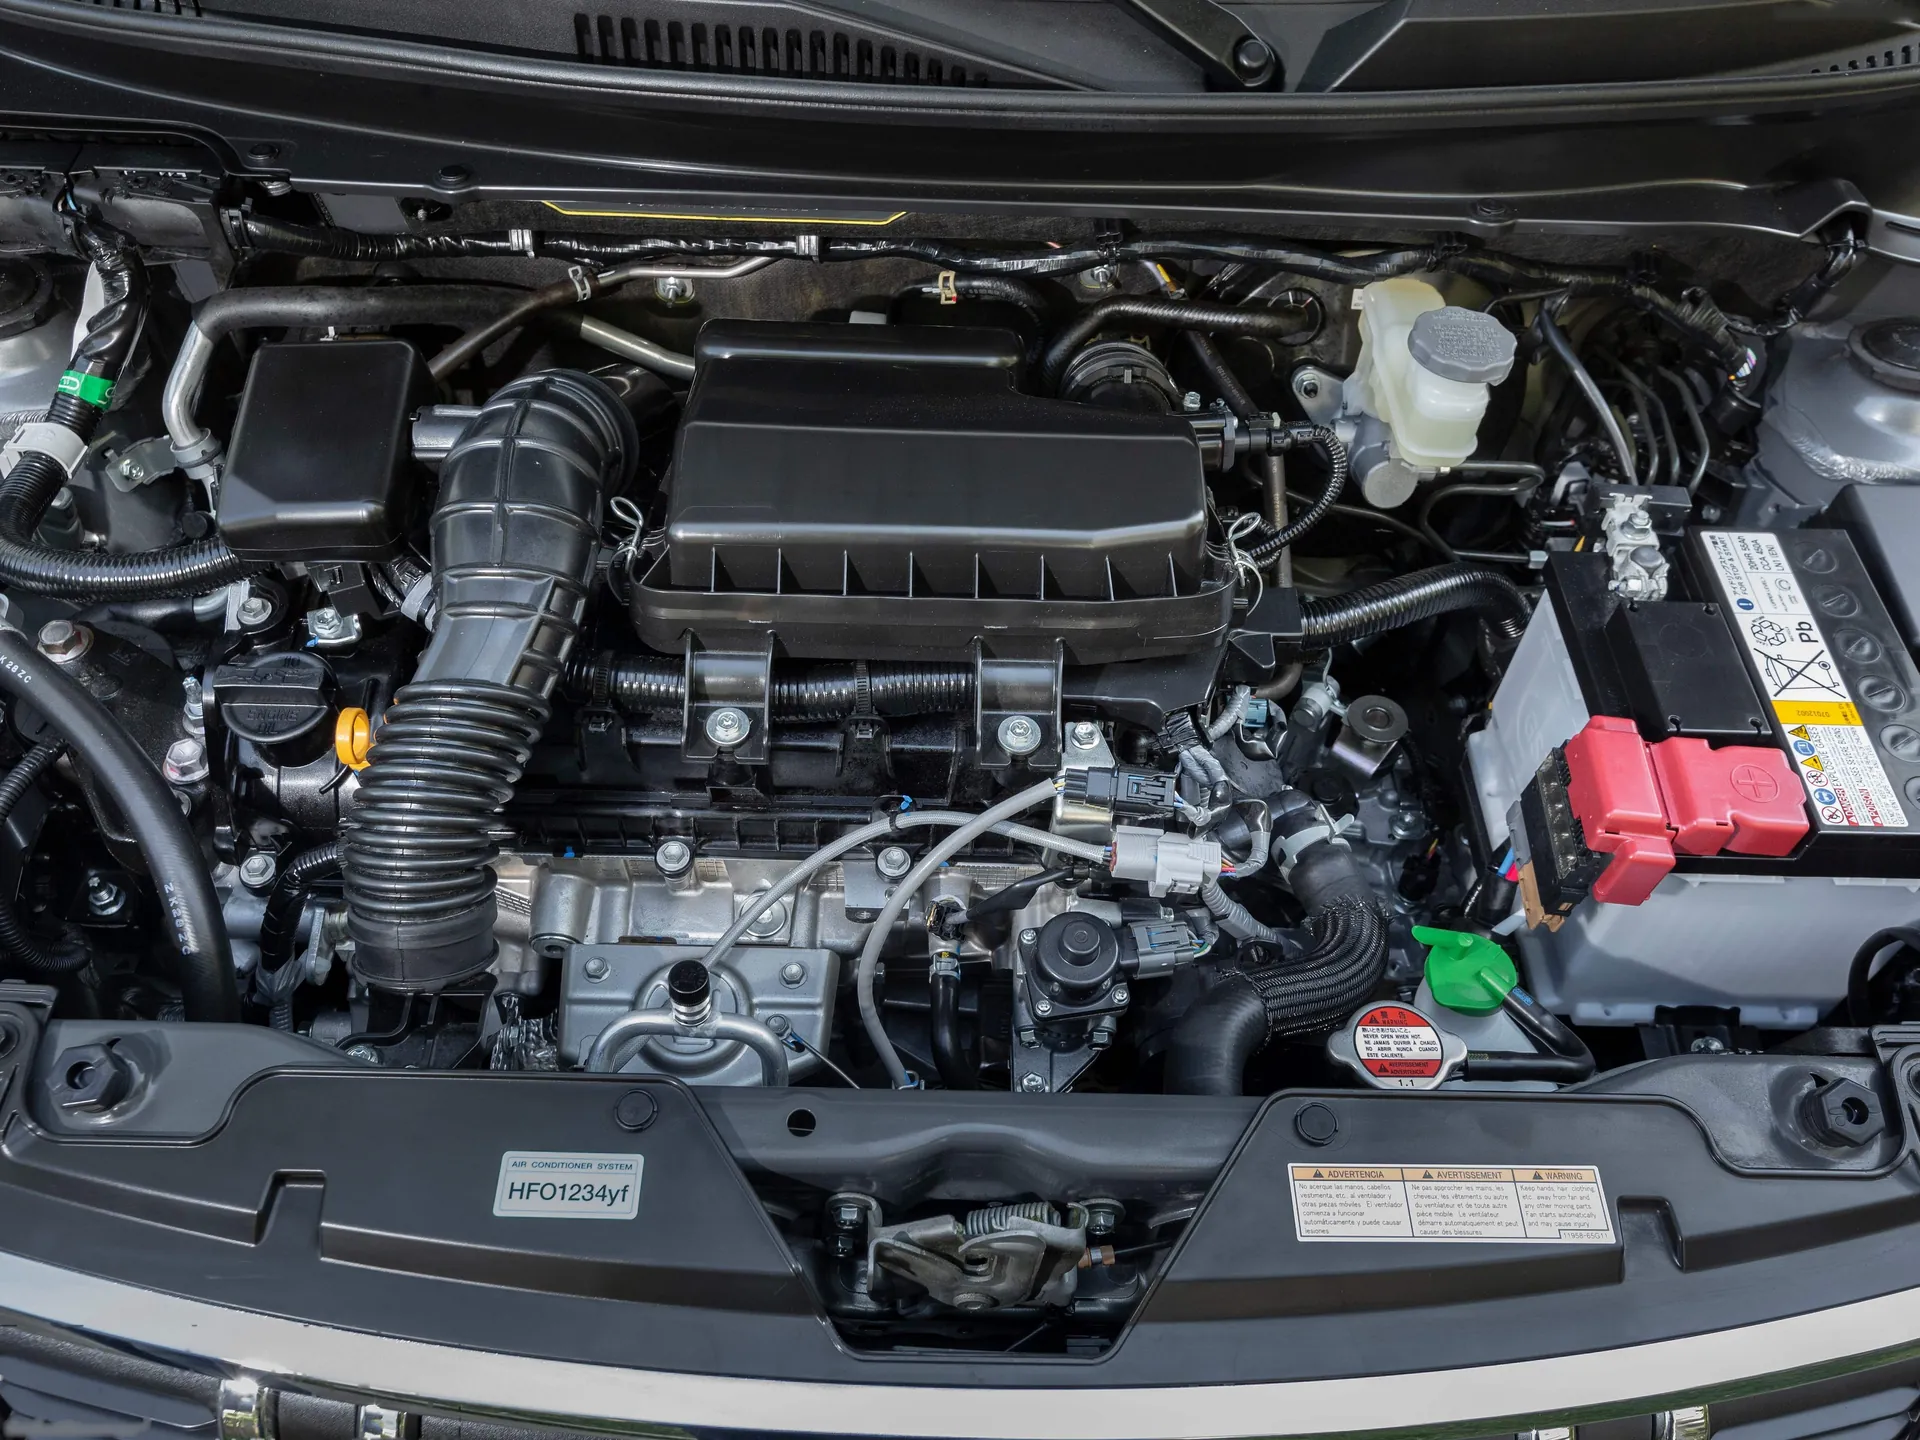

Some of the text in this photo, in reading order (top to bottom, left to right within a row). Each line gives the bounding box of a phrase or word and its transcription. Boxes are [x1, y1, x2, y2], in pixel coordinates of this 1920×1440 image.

[1718, 536, 1731, 556] START
[1737, 535, 1759, 570] 20HR 55Ah
[1751, 539, 1771, 570] CCA 450A
[1729, 563, 1742, 579] STOP
[1737, 581, 1748, 594] FOR
[1796, 622, 1818, 643] Pb
[0, 652, 32, 684] K28ZC
[247, 709, 299, 722] ENGINE
[1808, 726, 1824, 748] GASES
[1819, 750, 1842, 786] EXPLOSIVE
[1398, 1079, 1415, 1087] 1.1
[531, 1161, 593, 1170] CONDITIONER
[597, 1162, 633, 1170] SYSTEM
[1328, 1170, 1385, 1178] ADVERTENCIA
[1437, 1171, 1502, 1179] AVERTISSEMENT
[1545, 1172, 1583, 1180] WARNING
[508, 1182, 629, 1207] HFO1234yf
[1563, 1232, 1608, 1240] 11958-65G11
